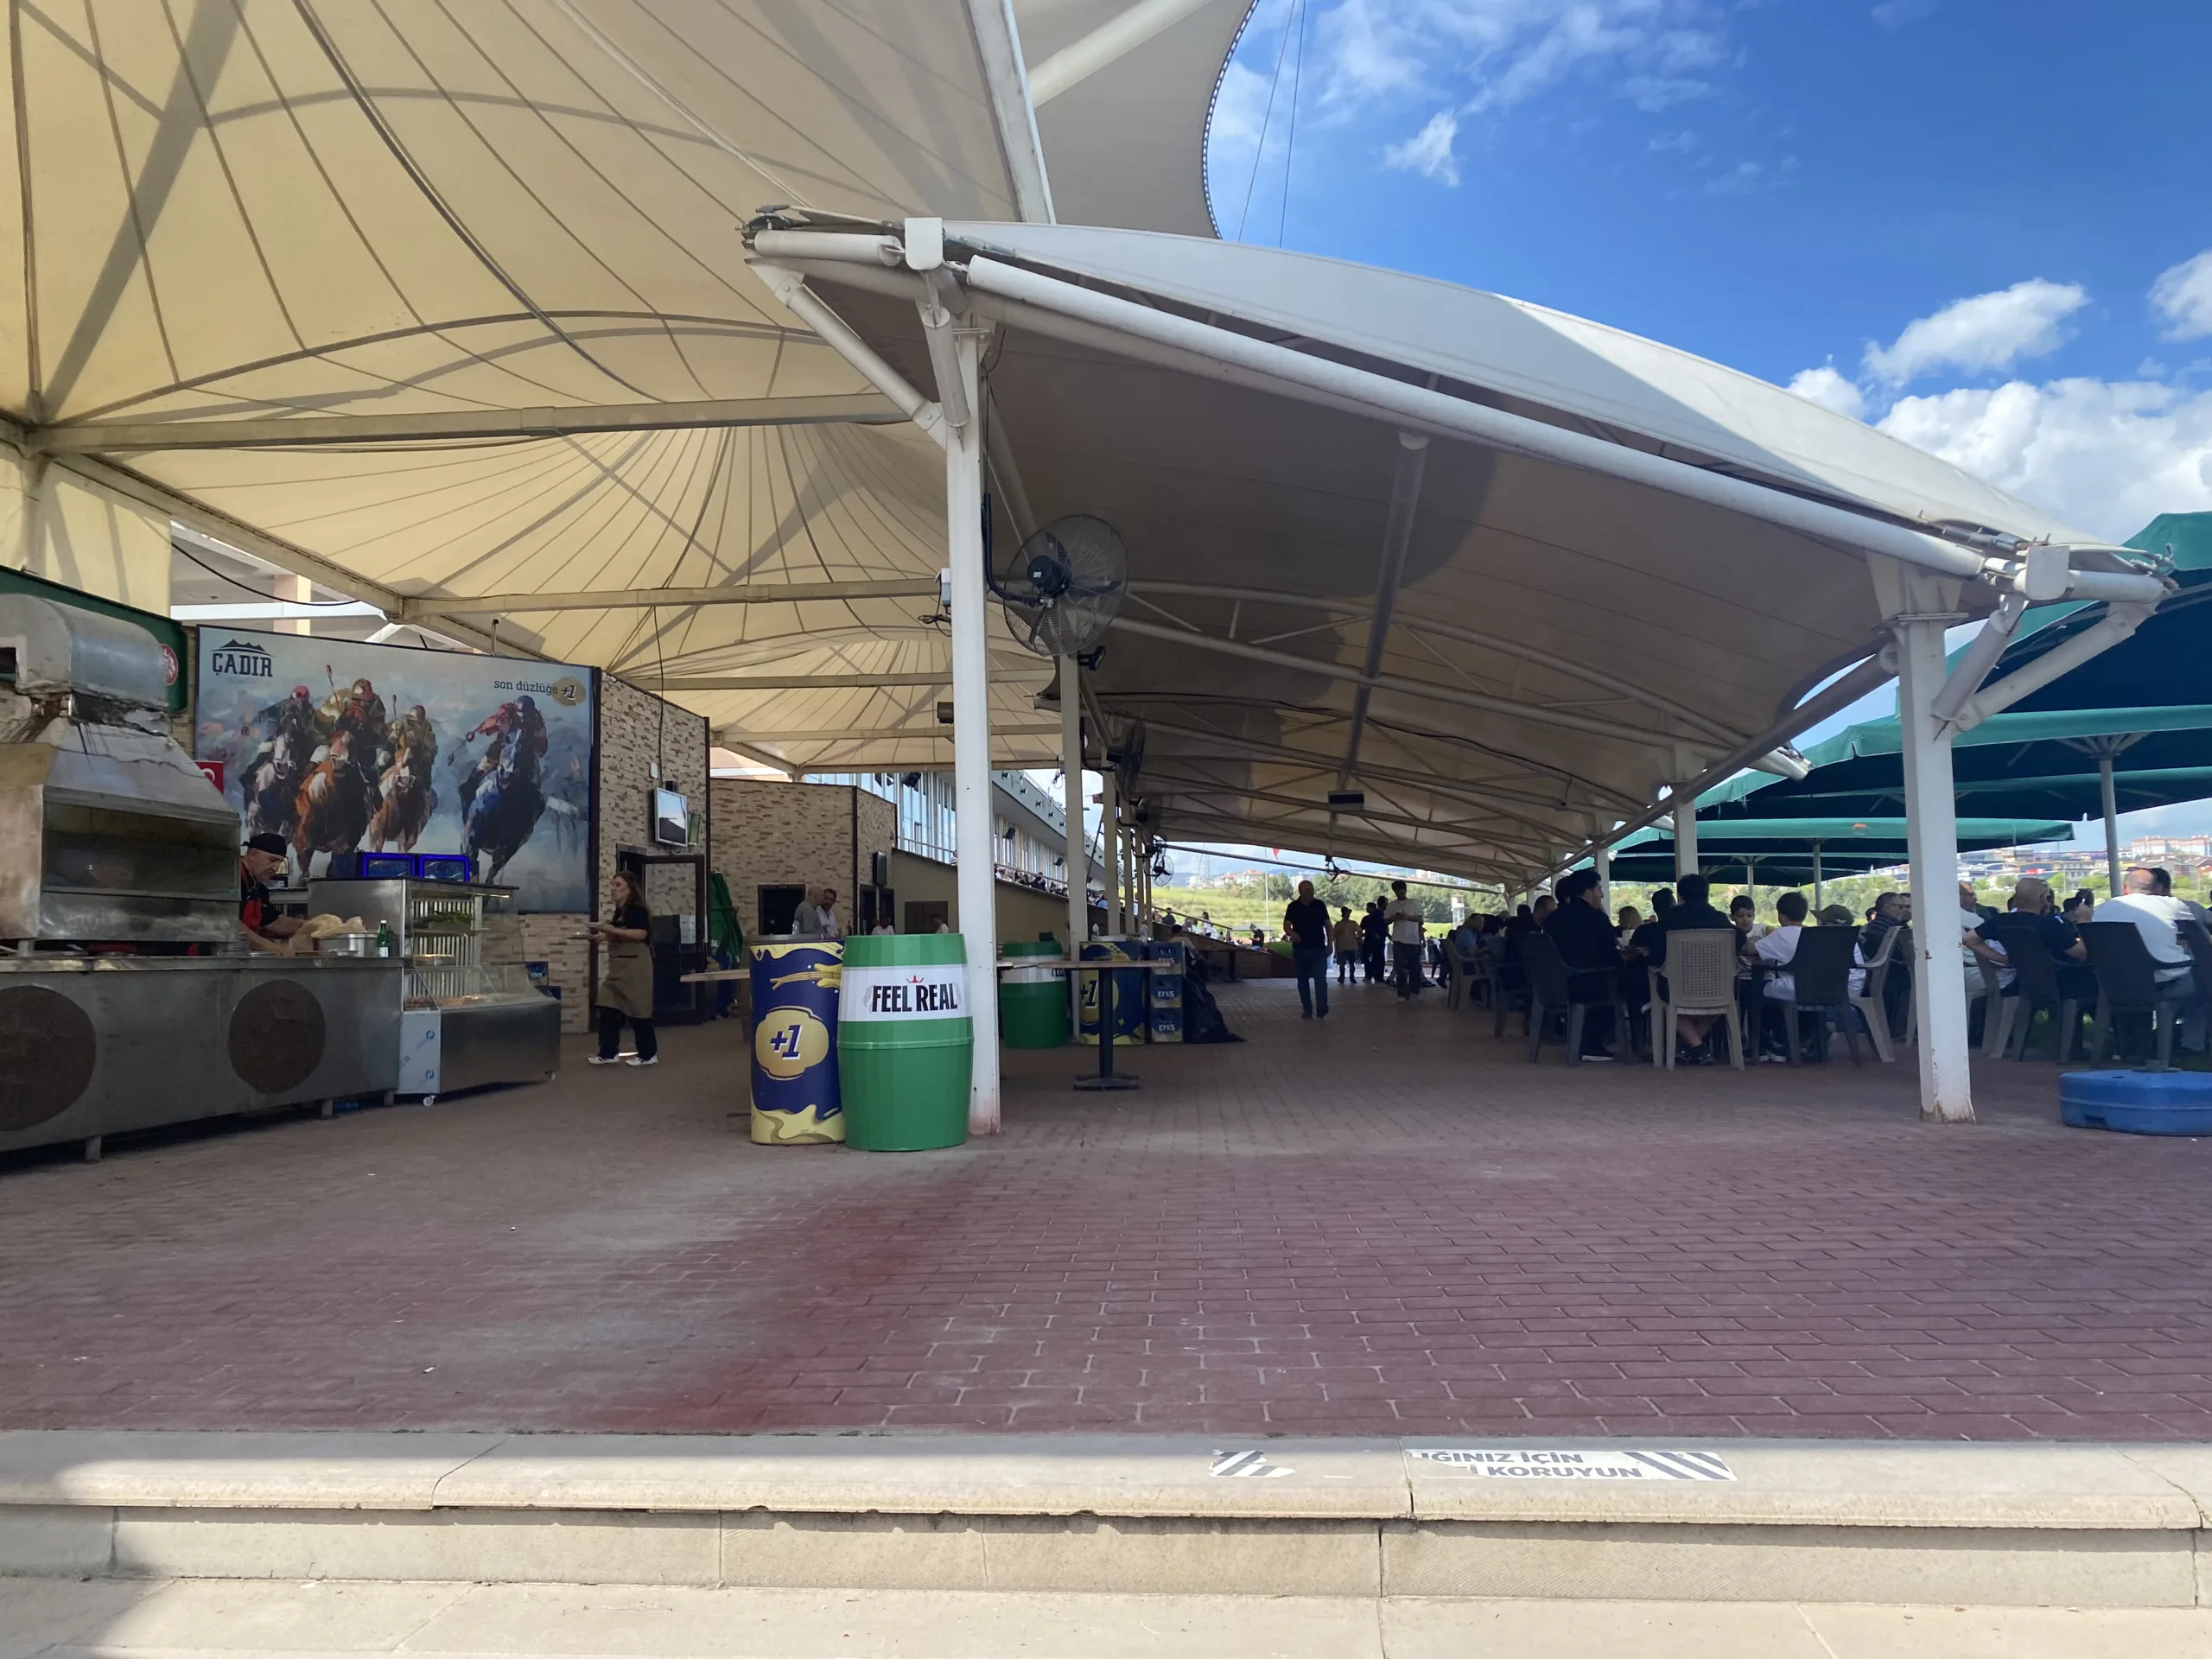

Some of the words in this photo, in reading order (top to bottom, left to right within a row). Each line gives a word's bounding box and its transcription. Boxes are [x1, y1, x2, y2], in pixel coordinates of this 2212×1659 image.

[213, 652, 273, 677] ÇADIR
[493, 680, 513, 690] son
[516, 681, 558, 696] düzlüğe
[562, 684, 576, 700] +1
[871, 985, 912, 1012] FEEL
[916, 983, 958, 1012] REAL
[770, 1025, 803, 1060] +1
[1410, 1451, 1514, 1463] IĞINIZ
[1520, 1451, 1584, 1465] İÇİN
[1487, 1466, 1643, 1478] KORUYUN
